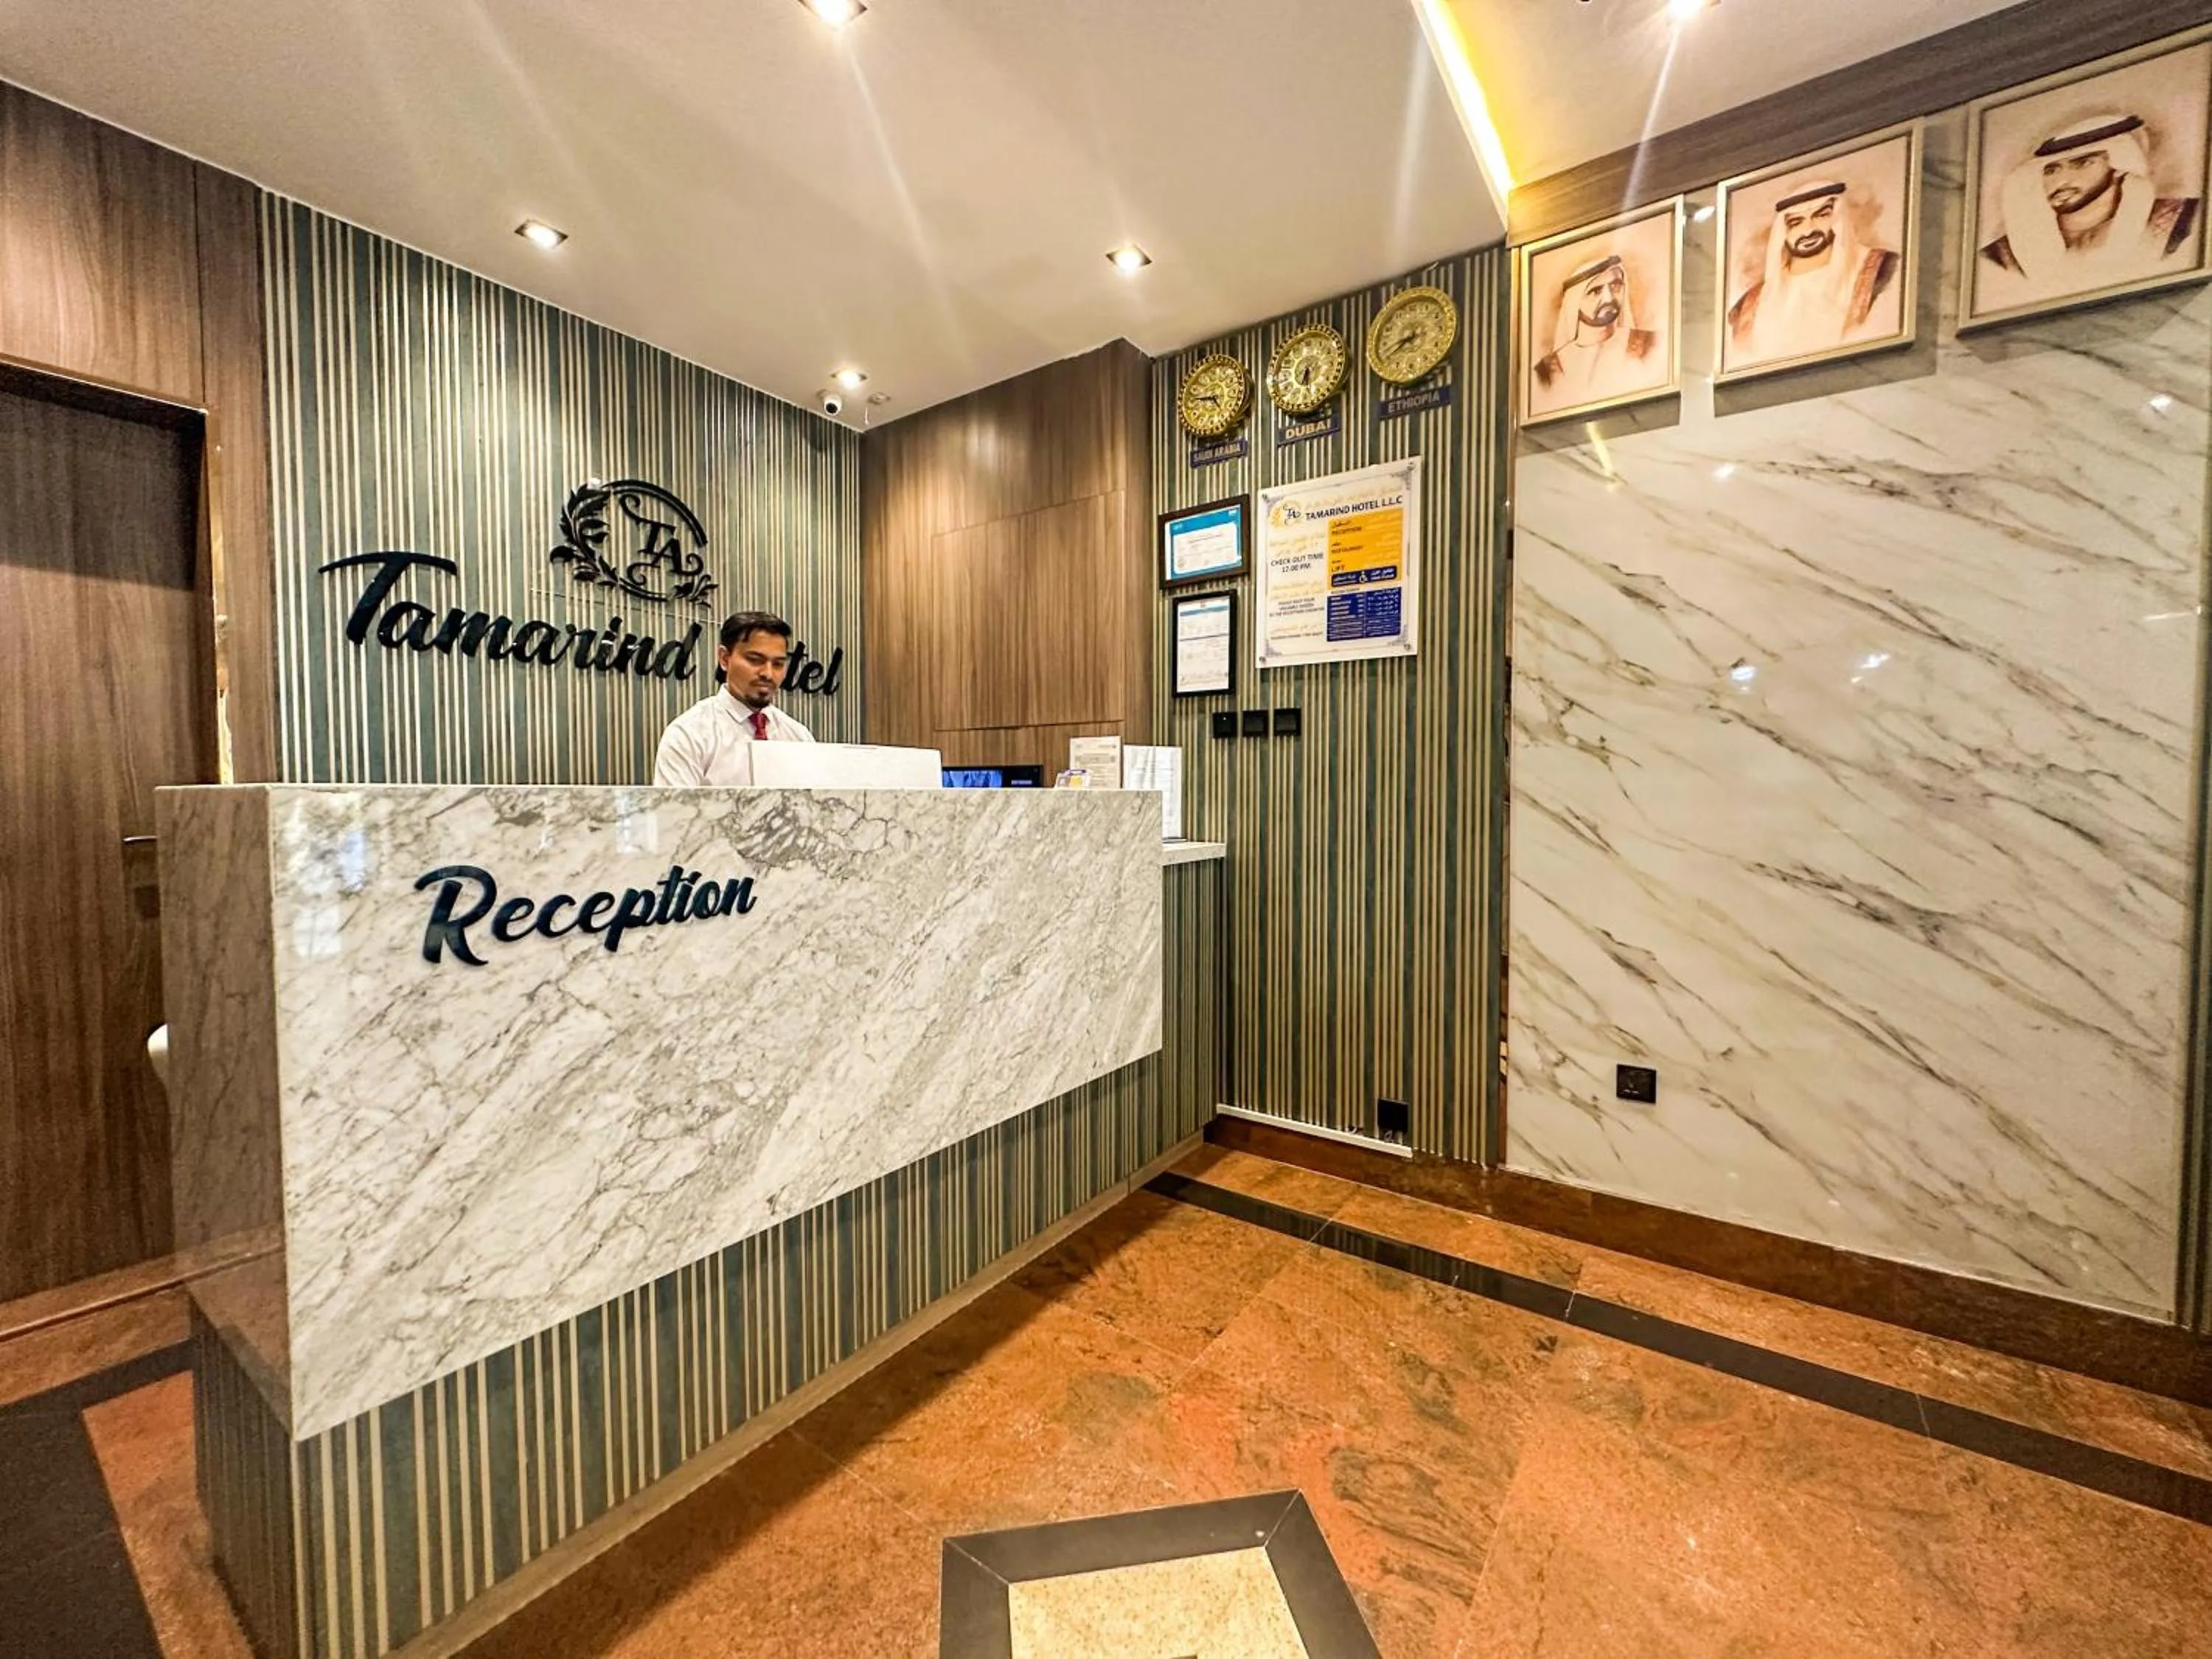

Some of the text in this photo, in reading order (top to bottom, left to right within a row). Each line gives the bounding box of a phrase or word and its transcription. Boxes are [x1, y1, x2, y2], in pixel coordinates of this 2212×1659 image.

[1388, 391, 1440, 414] ETHIOPIA
[1285, 420, 1332, 439] DUBAI
[1306, 505, 1350, 521] TAMARIND
[1352, 499, 1380, 513] HOTEL
[1270, 558, 1290, 567] CHECK
[1292, 554, 1306, 563] OUT
[319, 551, 844, 696] Tamarind tel
[414, 864, 758, 966] Reception
